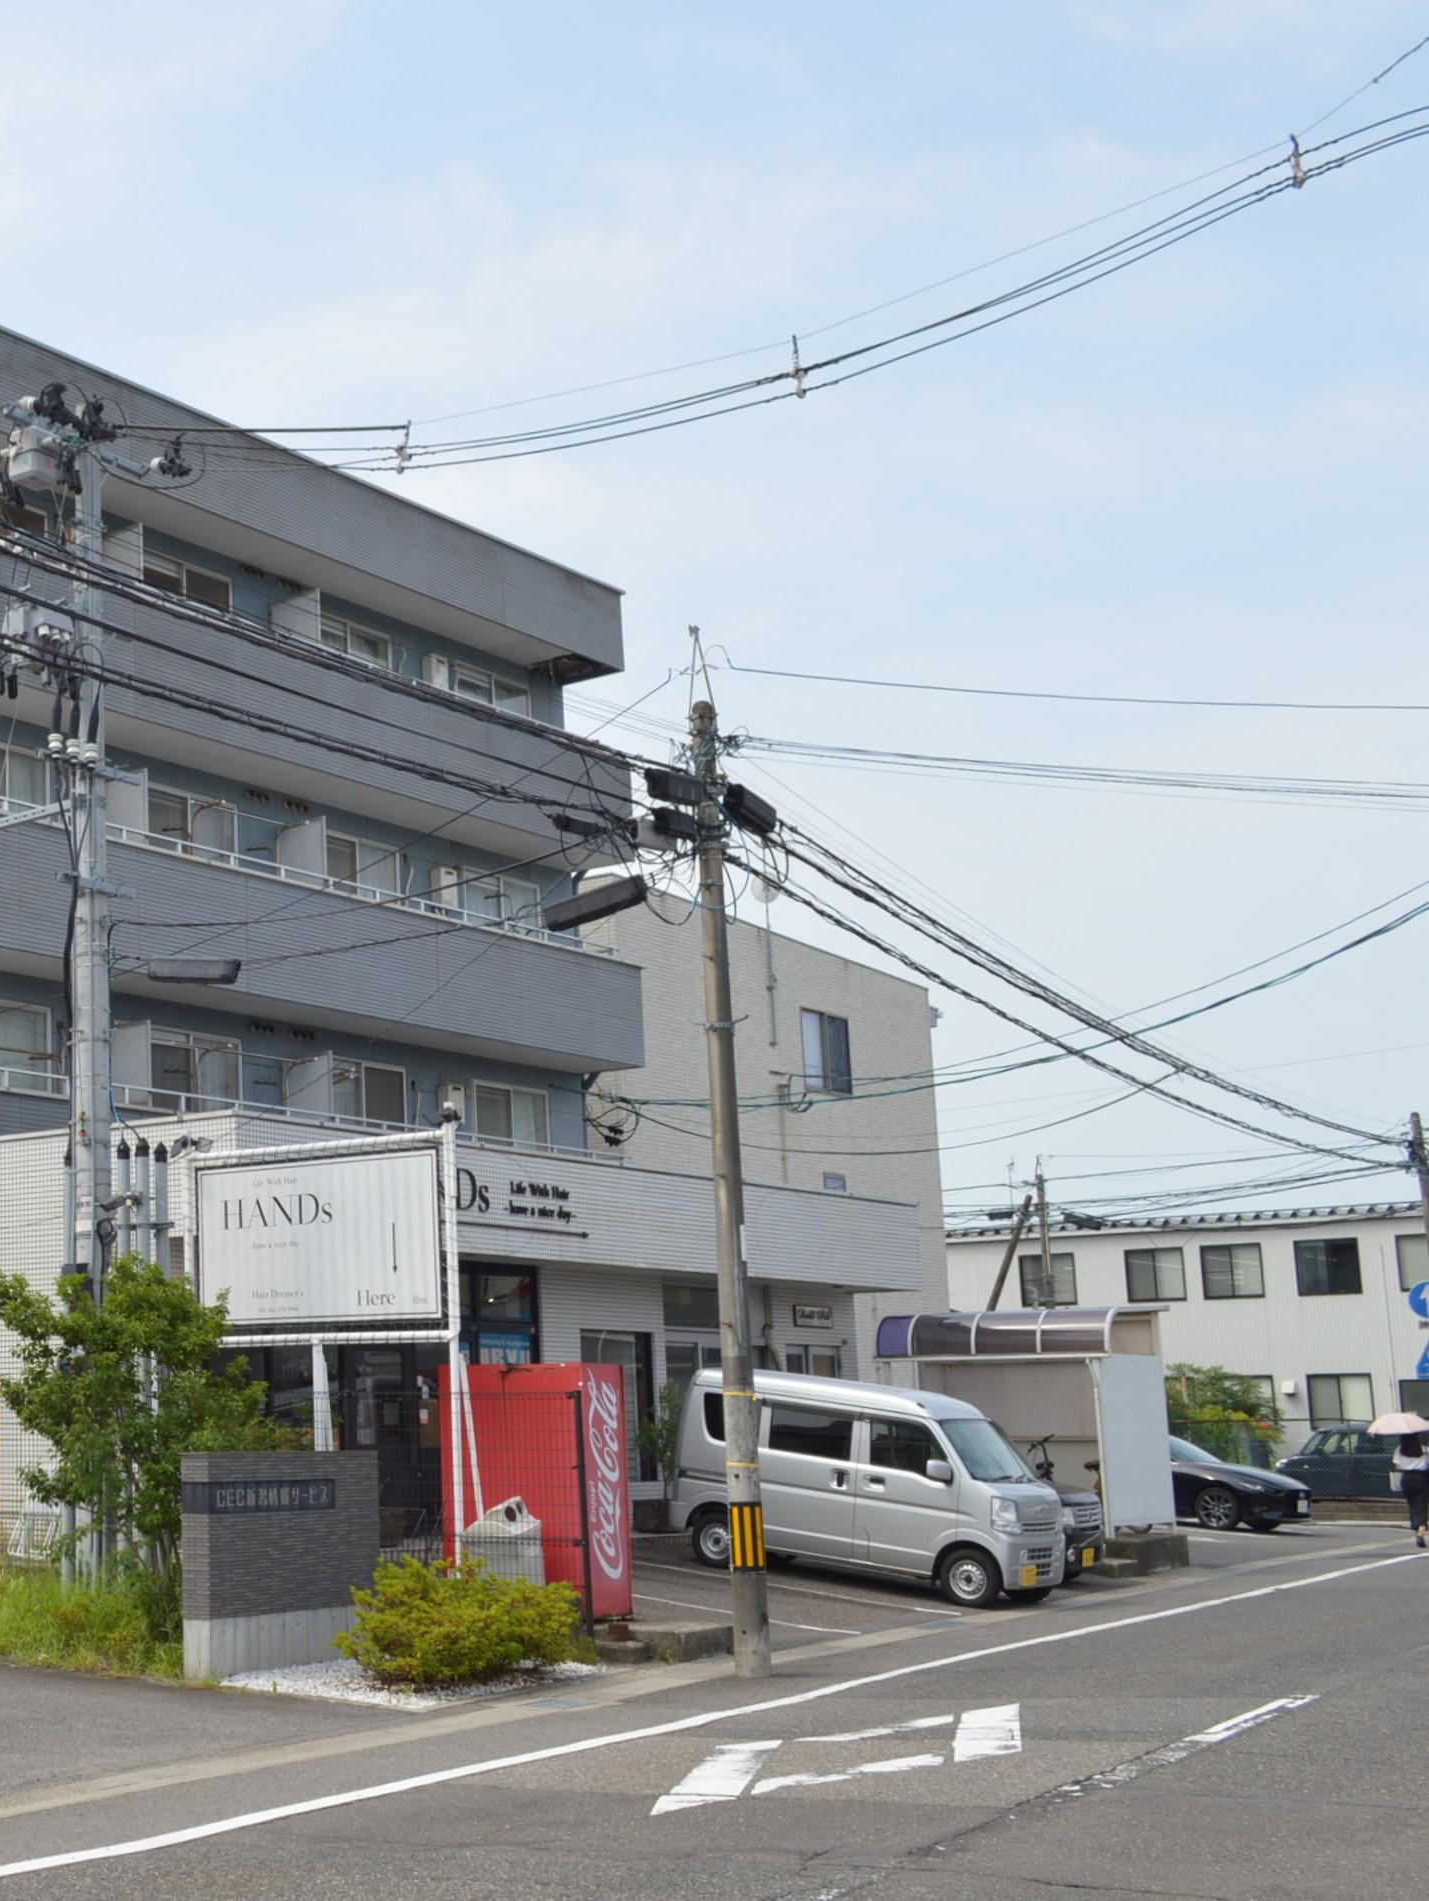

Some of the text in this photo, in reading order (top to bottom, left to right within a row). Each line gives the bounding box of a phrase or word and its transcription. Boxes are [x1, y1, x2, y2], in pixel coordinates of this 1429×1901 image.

[551, 1186, 570, 1200] Hair
[222, 1192, 333, 1231] HANDs
[356, 1289, 396, 1306] Here
